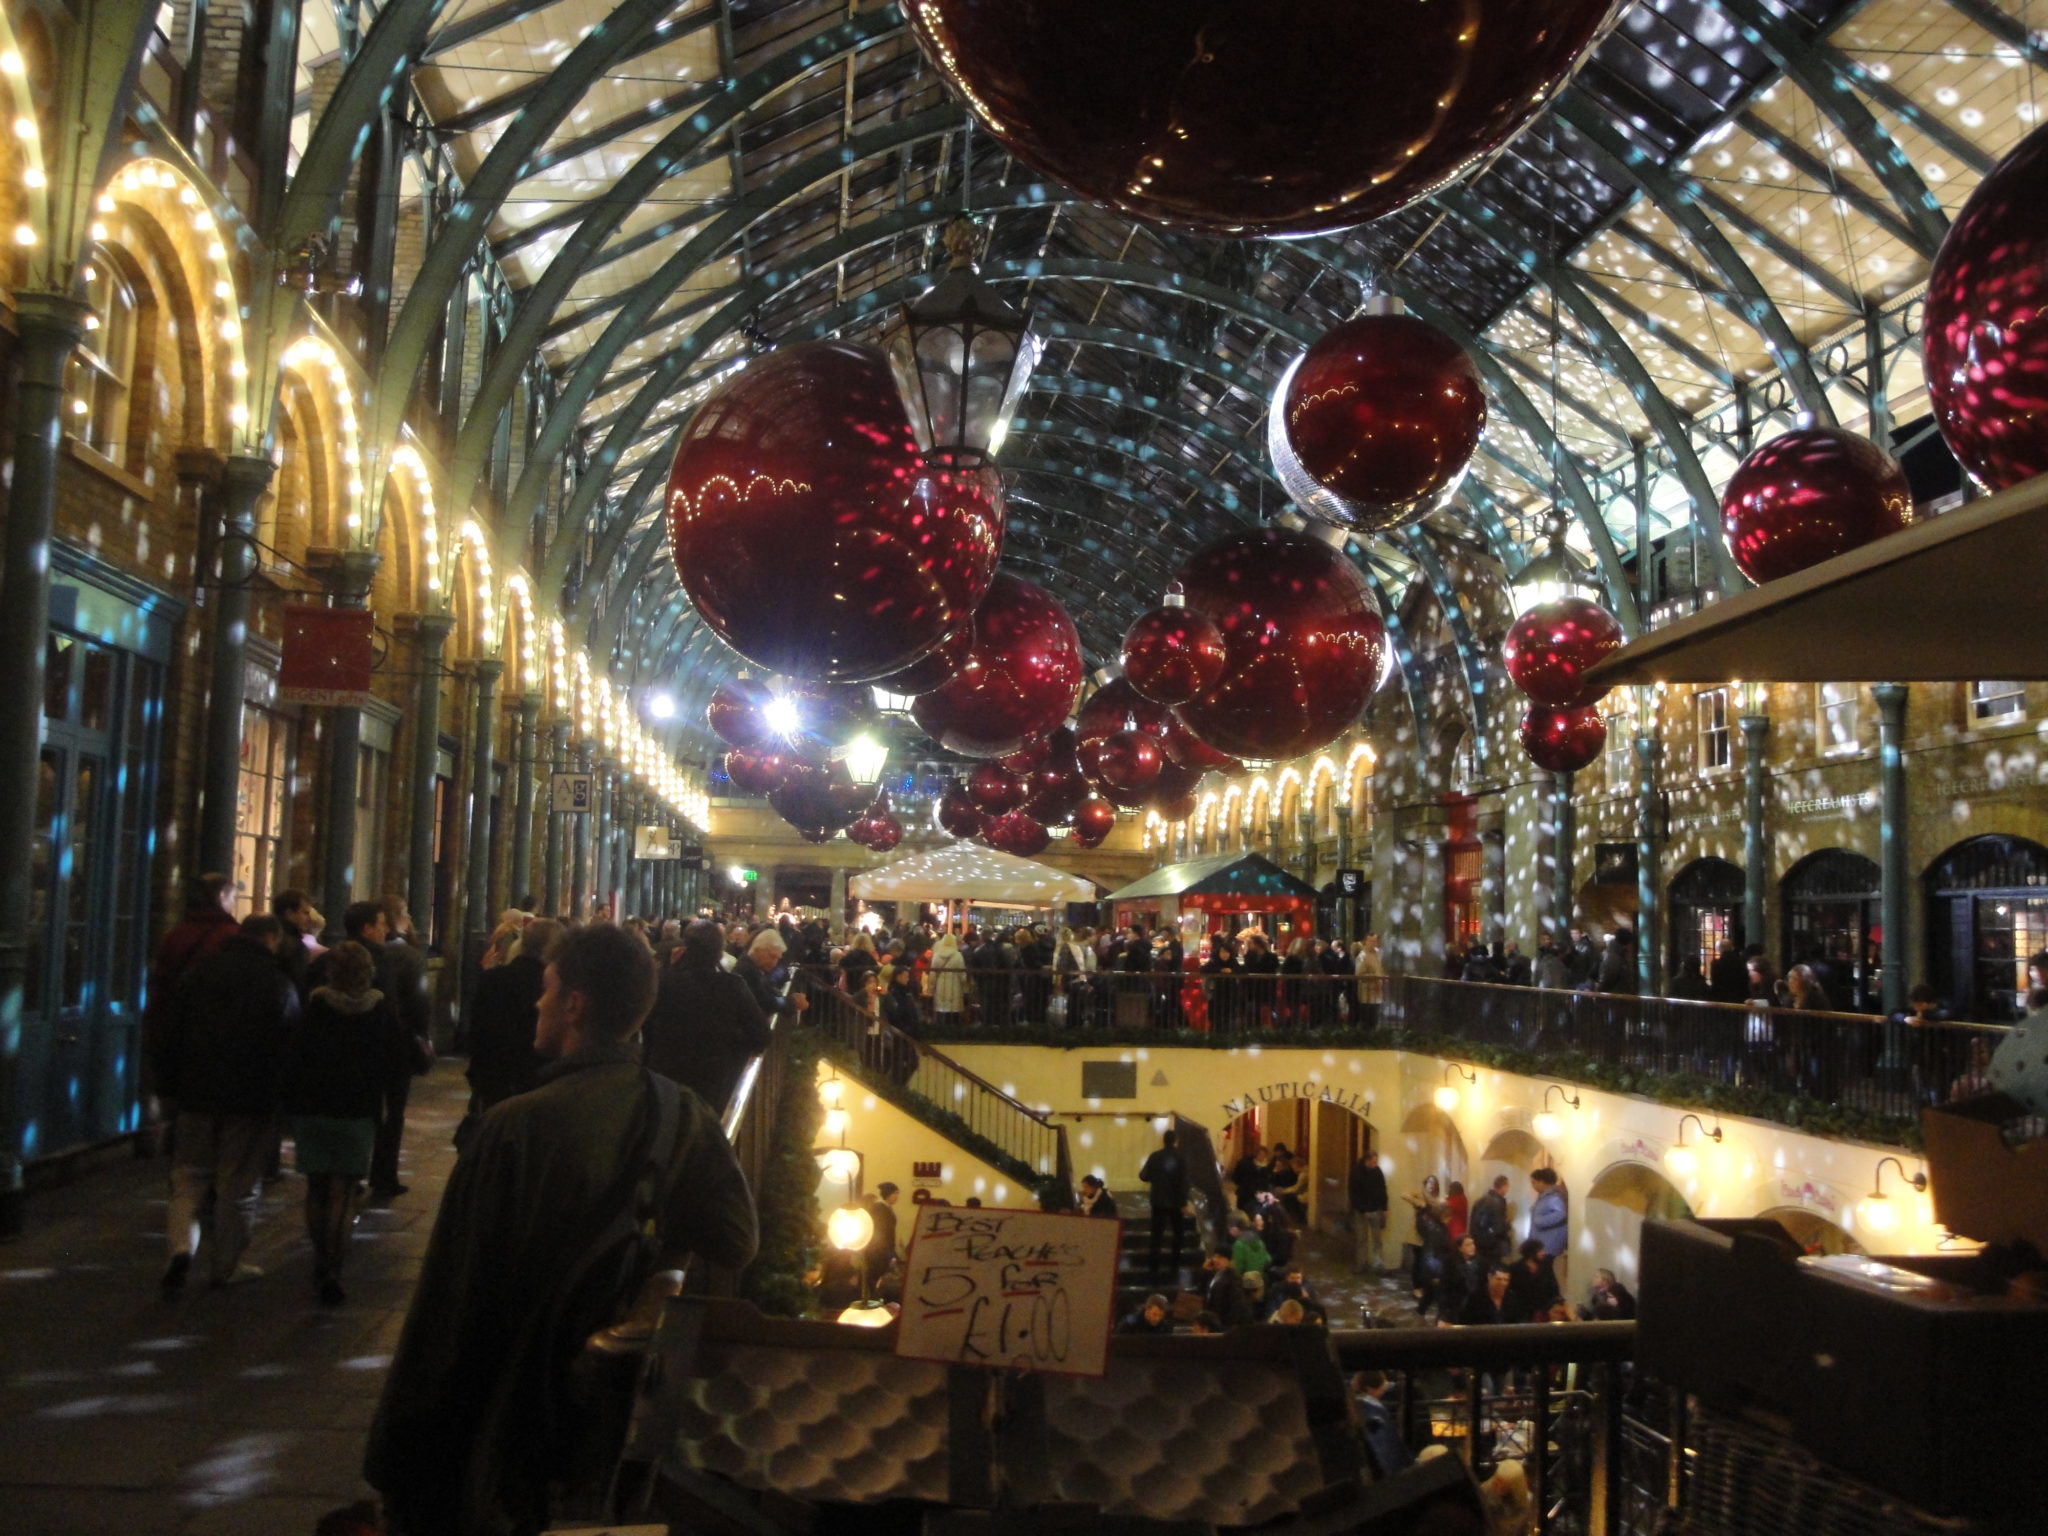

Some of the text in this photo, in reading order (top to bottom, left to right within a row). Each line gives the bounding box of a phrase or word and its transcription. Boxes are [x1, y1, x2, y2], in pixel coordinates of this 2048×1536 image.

[1222, 1081, 1372, 1118] NAUTICALIA
[918, 1266, 976, 1307] 5
[960, 1287, 1071, 1363] £1.00
